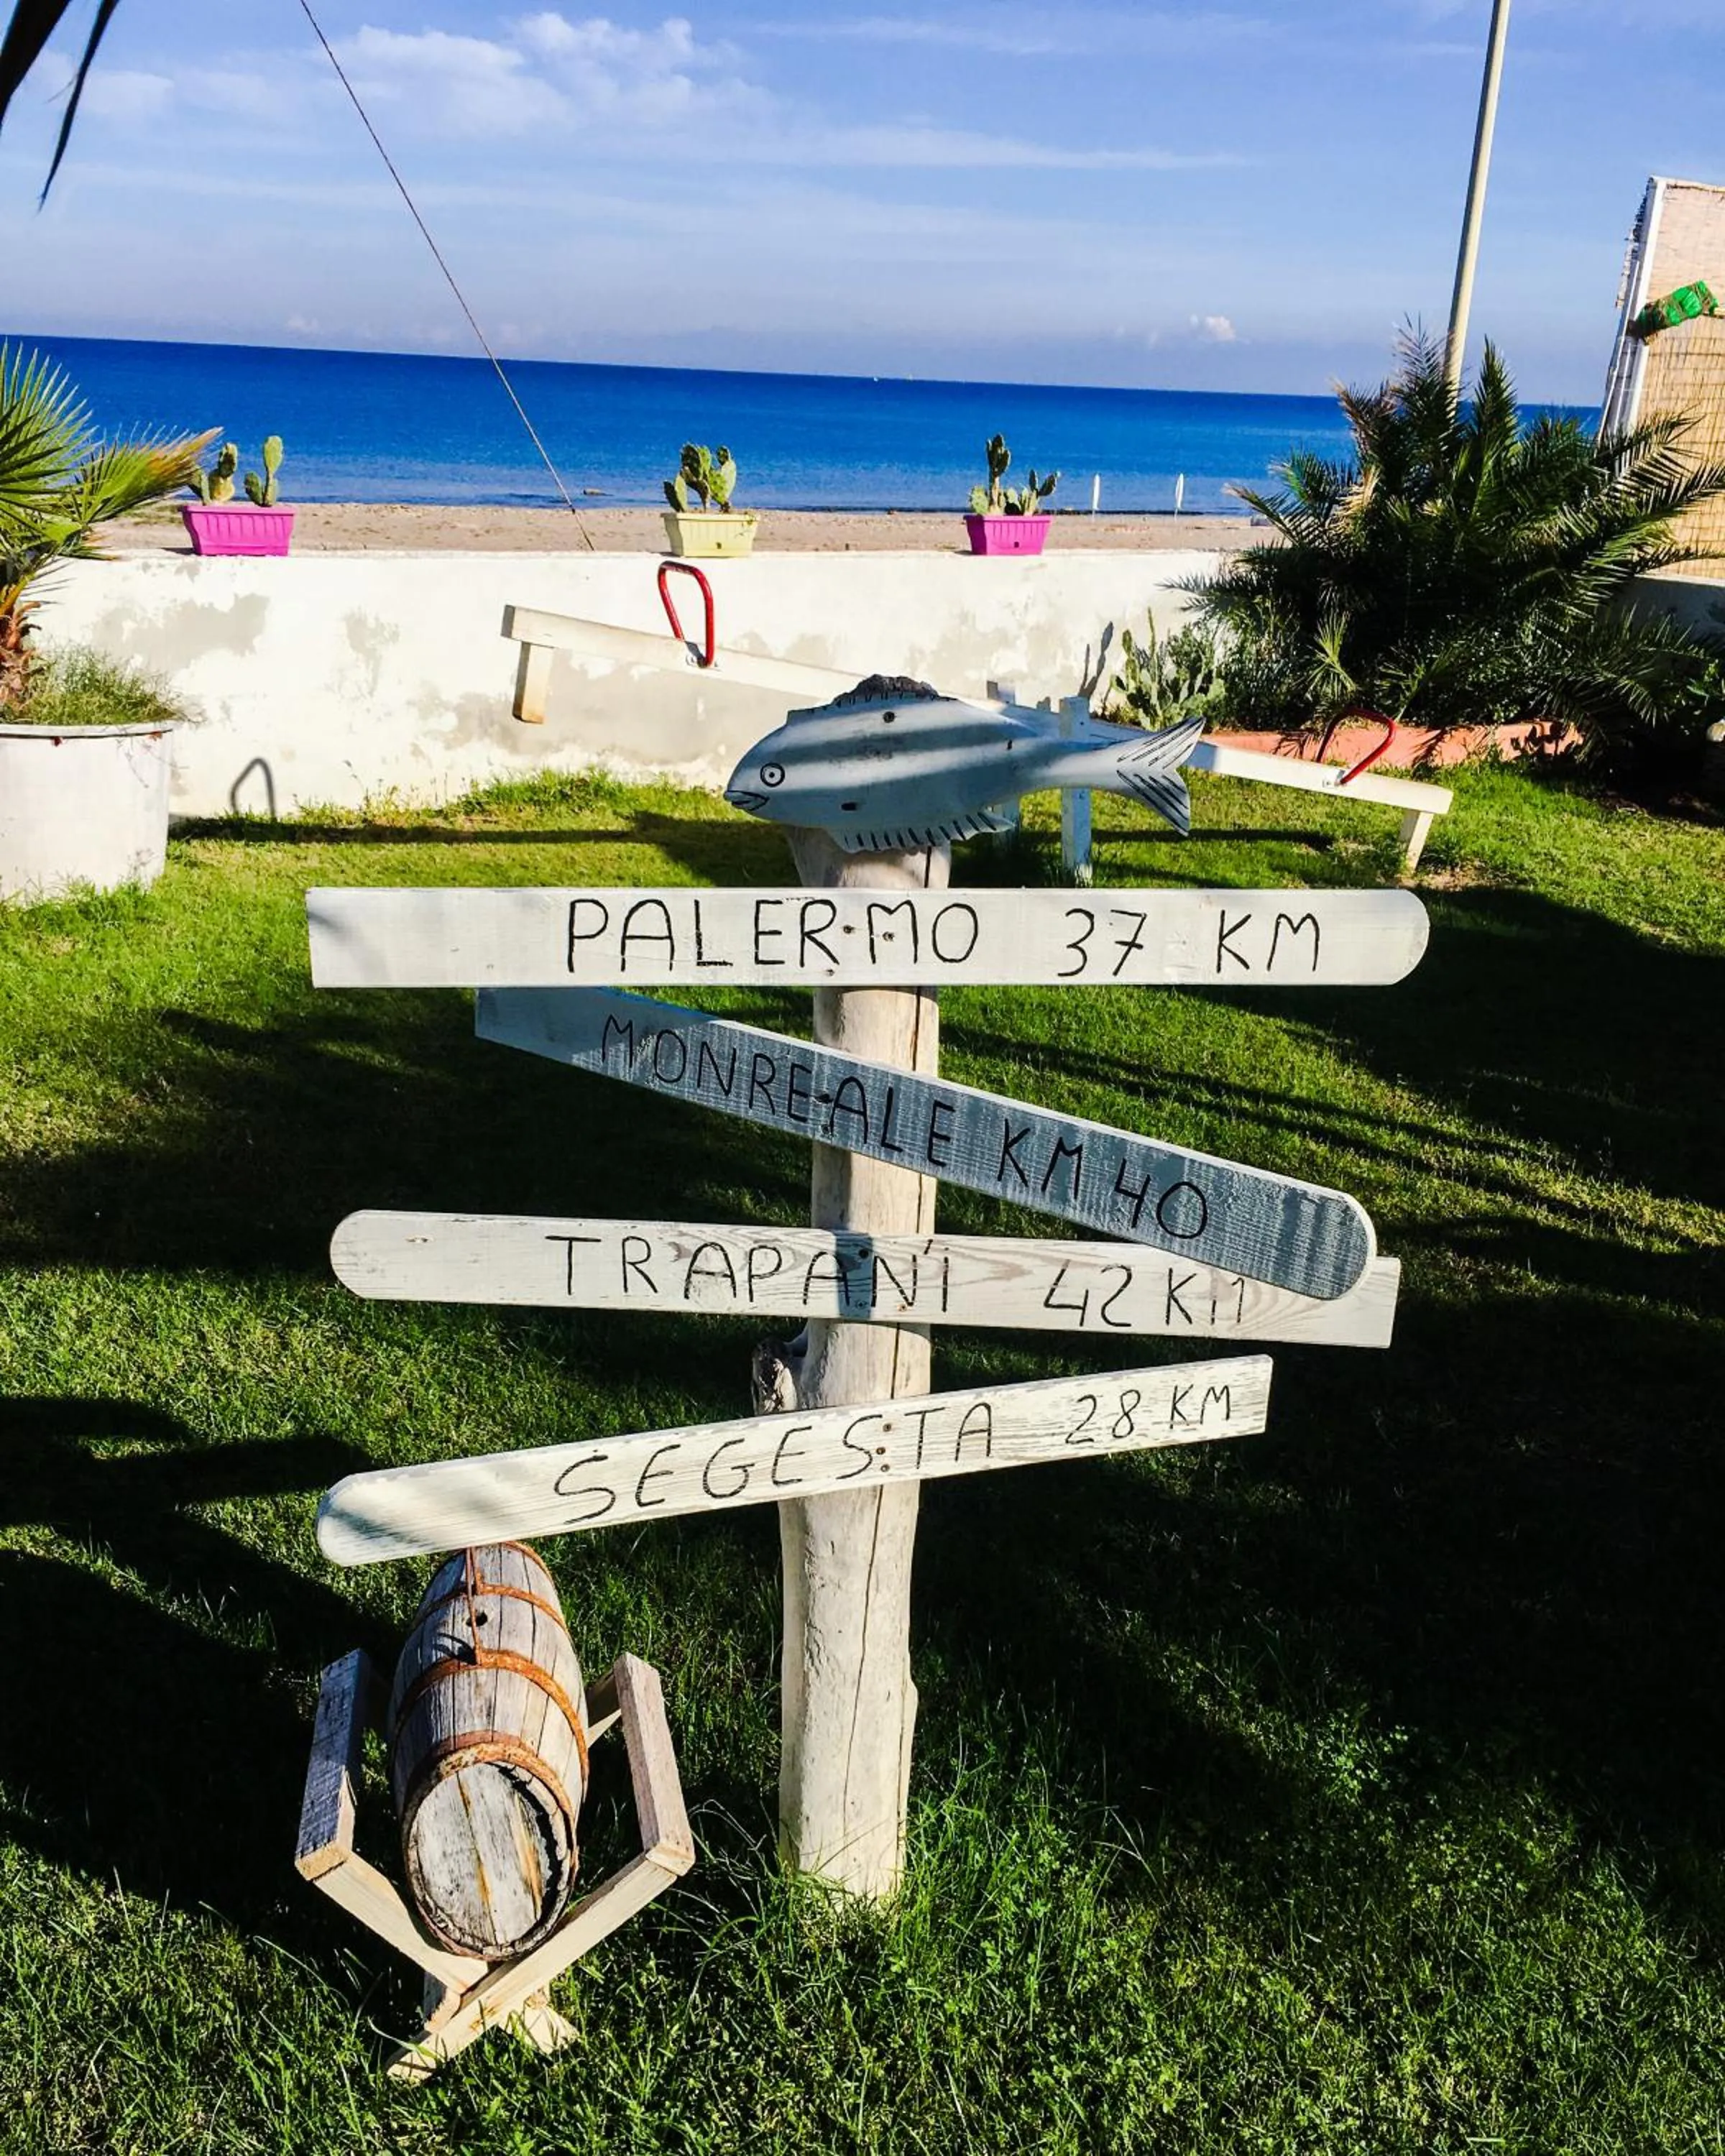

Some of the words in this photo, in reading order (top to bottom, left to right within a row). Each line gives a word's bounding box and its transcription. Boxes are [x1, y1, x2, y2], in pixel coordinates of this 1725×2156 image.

[566, 898, 979, 973] PALERMO
[1057, 908, 1148, 977] 37
[1216, 910, 1321, 973] KM
[601, 1013, 957, 1168] MONREALE
[997, 1118, 1083, 1200] KM
[1114, 1158, 1208, 1239] 40
[1044, 1259, 1133, 1328] 42
[553, 1402, 992, 1524] SEGESTA
[1064, 1389, 1141, 1445] 28
[1169, 1384, 1231, 1430] KM
